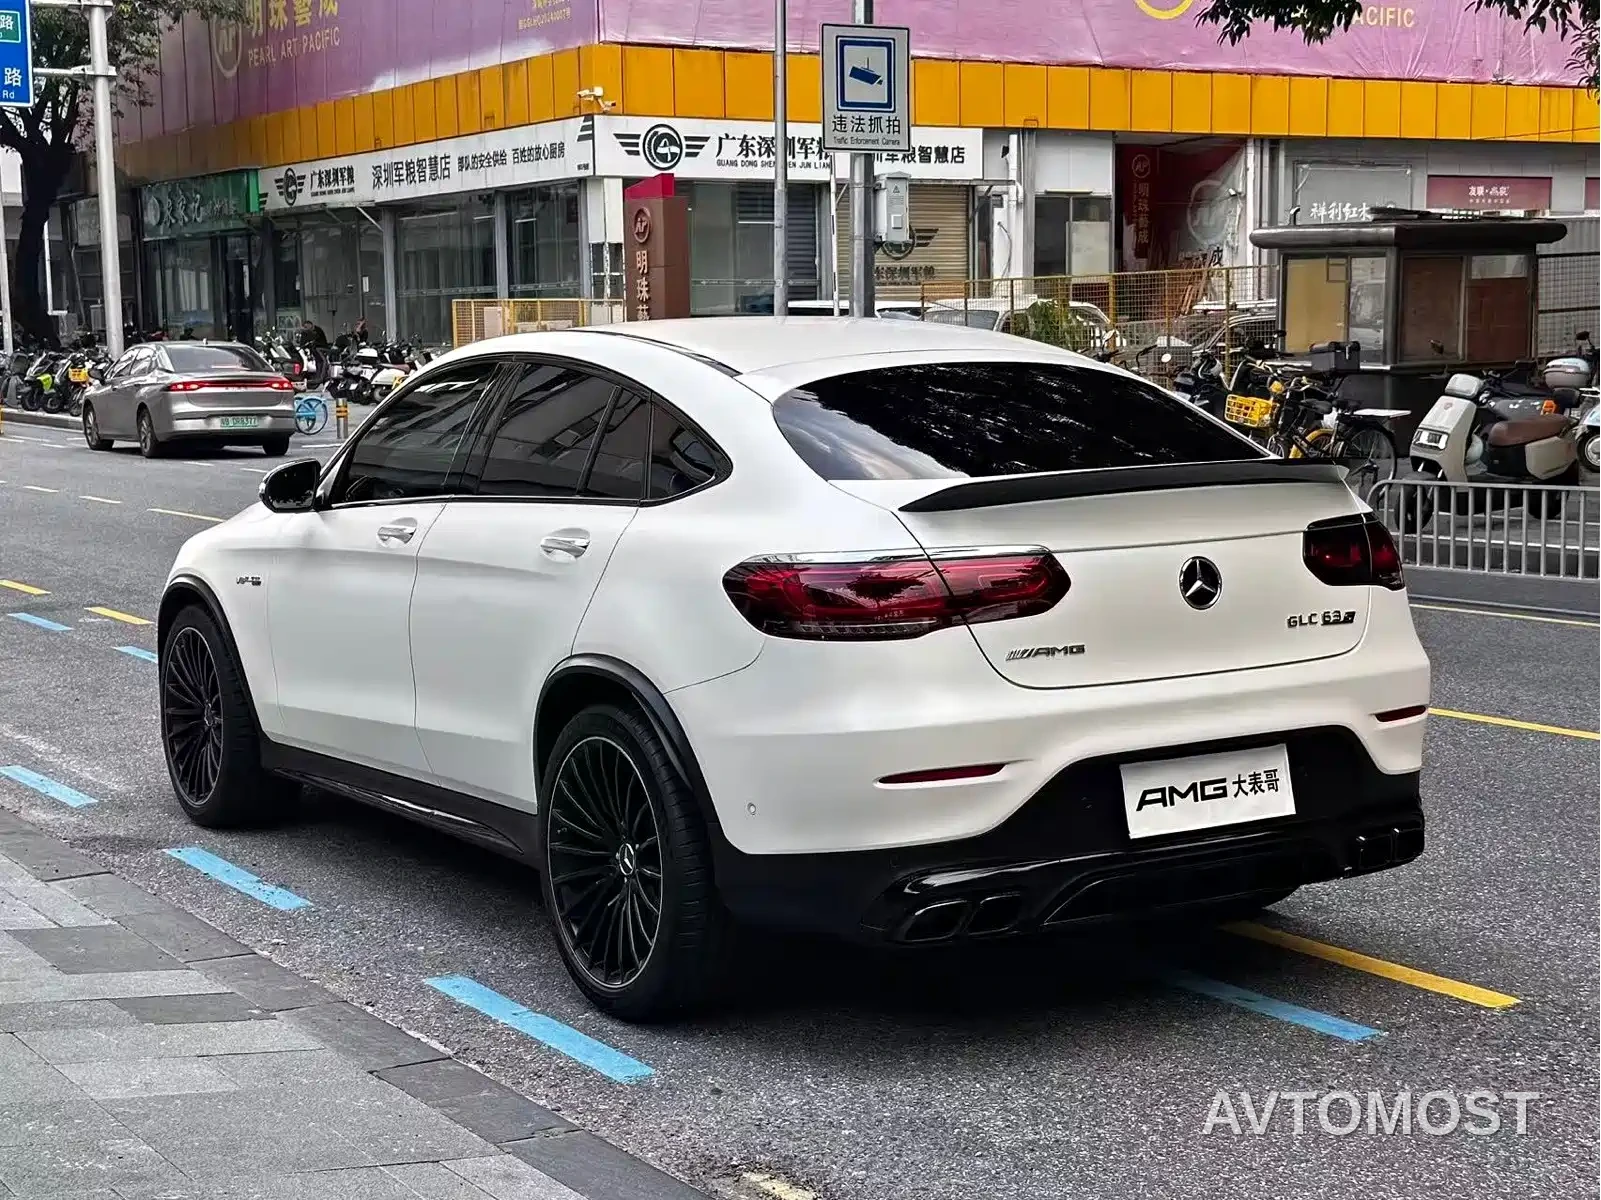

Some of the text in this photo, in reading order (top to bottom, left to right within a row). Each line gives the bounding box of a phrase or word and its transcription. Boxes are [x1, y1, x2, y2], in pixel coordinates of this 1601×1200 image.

[248, 27, 340, 68] PEARL ART PACIFIC
[4, 68, 22, 87] 路
[3, 90, 15, 99] Rd
[832, 114, 900, 134] 违法抓拍
[457, 141, 565, 173] 部队的安全供给 百姓的放心厨房
[716, 159, 738, 168] GUANG
[740, 160, 758, 168] DONG
[799, 161, 812, 169] JUN
[814, 161, 830, 170] LIAN
[310, 154, 451, 191] 广东深圳军粮 深圳军粮智慧店
[1287, 613, 1318, 629] GLC
[1031, 644, 1085, 658] AMG
[1136, 768, 1280, 812] AMG 大表哥
